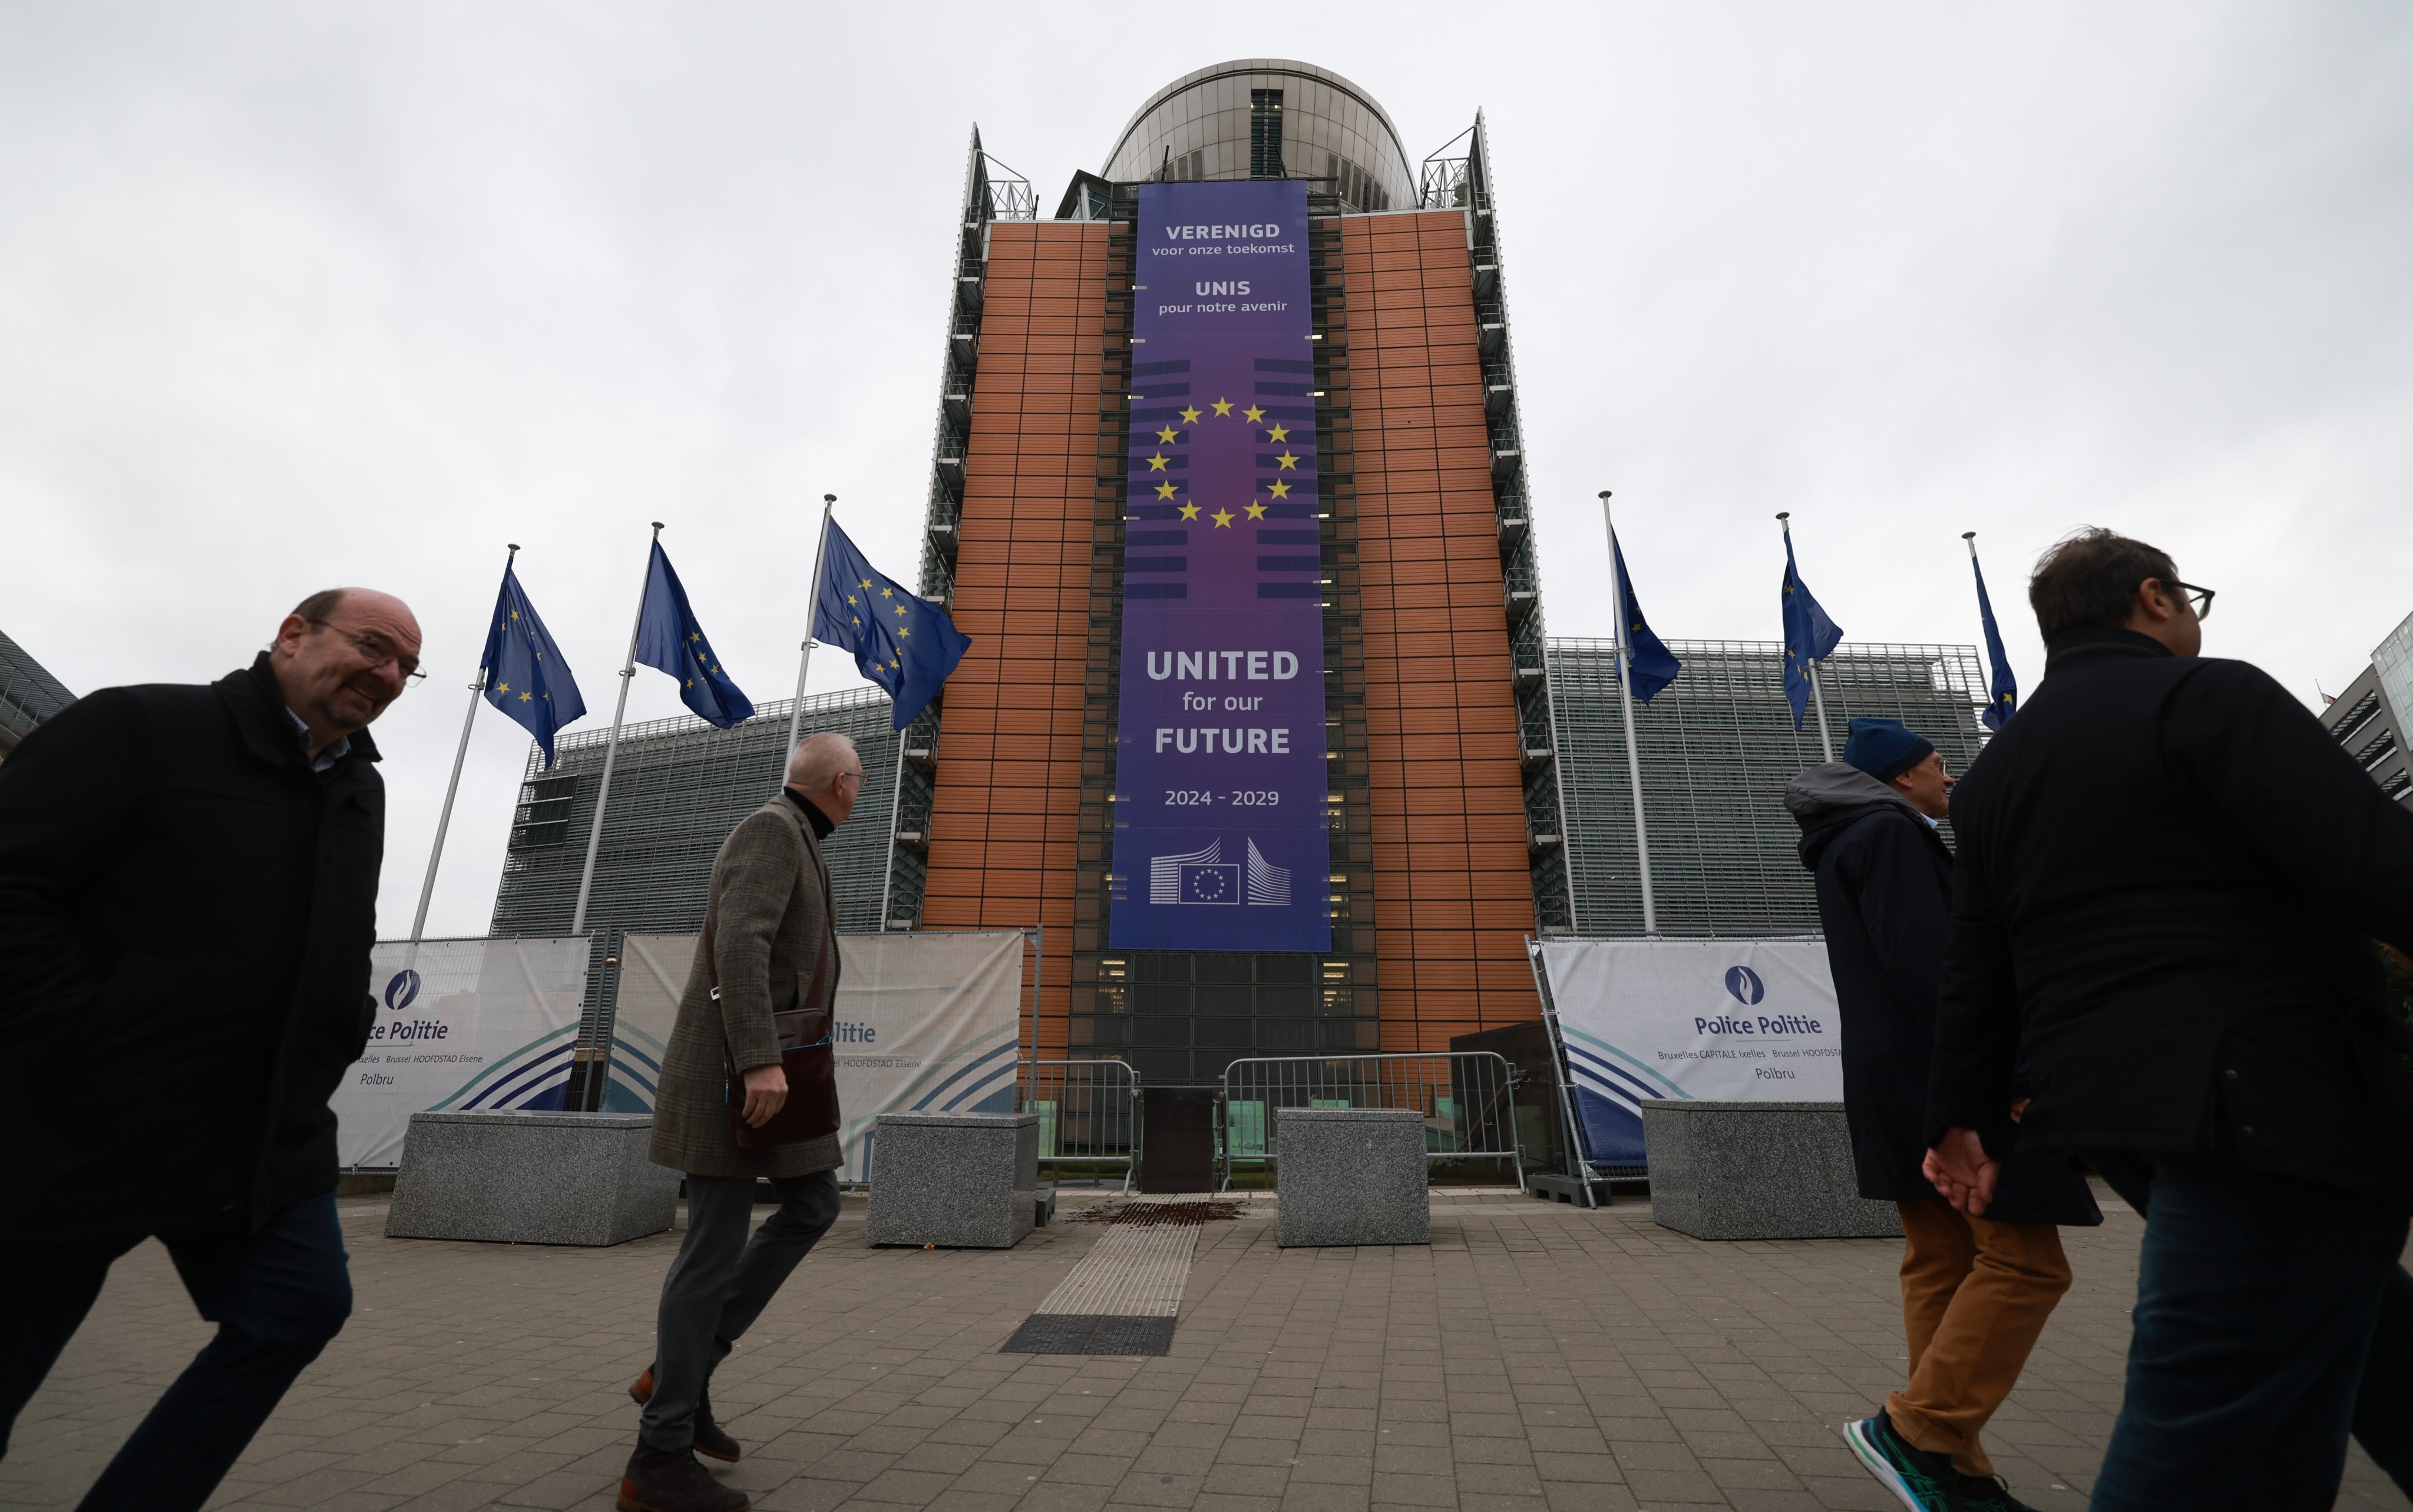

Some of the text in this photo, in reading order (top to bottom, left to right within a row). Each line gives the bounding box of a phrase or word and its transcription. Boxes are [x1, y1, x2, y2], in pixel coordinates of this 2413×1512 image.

[1166, 224, 1280, 239] VERENIGD
[1152, 243, 1295, 256] voor onze toekomst
[1196, 281, 1251, 296] UNIS
[1159, 301, 1287, 316] pour notre avenir
[1147, 651, 1298, 680] UNITED
[1183, 692, 1262, 710] for our
[1156, 728, 1290, 754] FUTURE
[1165, 790, 1212, 805] 2024
[1232, 791, 1279, 806] 2029
[389, 1020, 448, 1040] Politie
[834, 1022, 875, 1043] litie
[1694, 1015, 1823, 1035] Police Politie
[1658, 1051, 1698, 1060] Bruxelles
[1700, 1050, 1737, 1058] CAPITALE
[1738, 1049, 1766, 1058] Ixelles
[1772, 1049, 1800, 1057] Brussel
[844, 1059, 893, 1067] HOOFDSTAD
[360, 1073, 394, 1084] Polbru
[1756, 1067, 1795, 1079] Polbru
